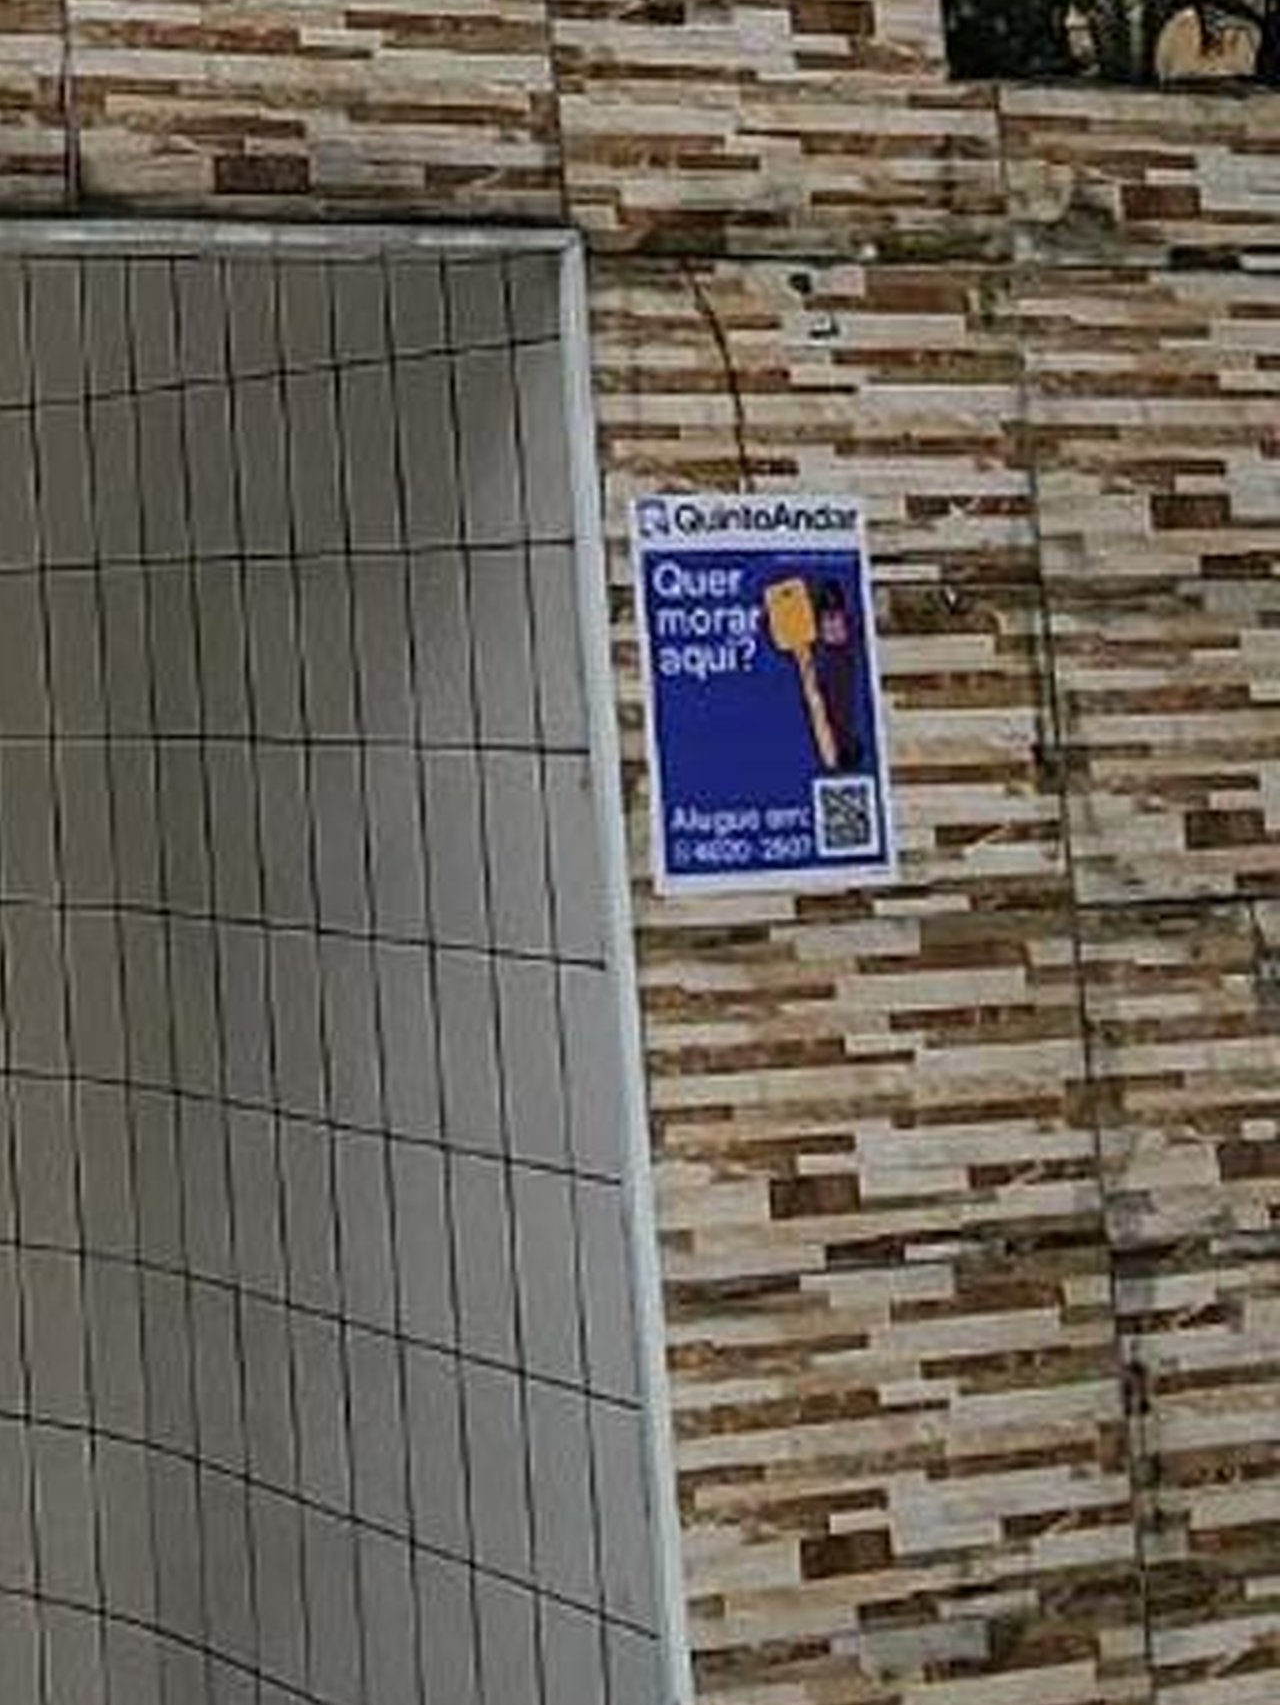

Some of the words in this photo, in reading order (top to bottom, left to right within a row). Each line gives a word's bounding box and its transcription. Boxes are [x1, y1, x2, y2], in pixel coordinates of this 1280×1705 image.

[674, 500, 859, 533] QuintoAndar
[651, 561, 744, 598] Quer
[656, 604, 761, 636] morar
[657, 637, 757, 681] aqui?
[669, 804, 761, 838] Alugue
